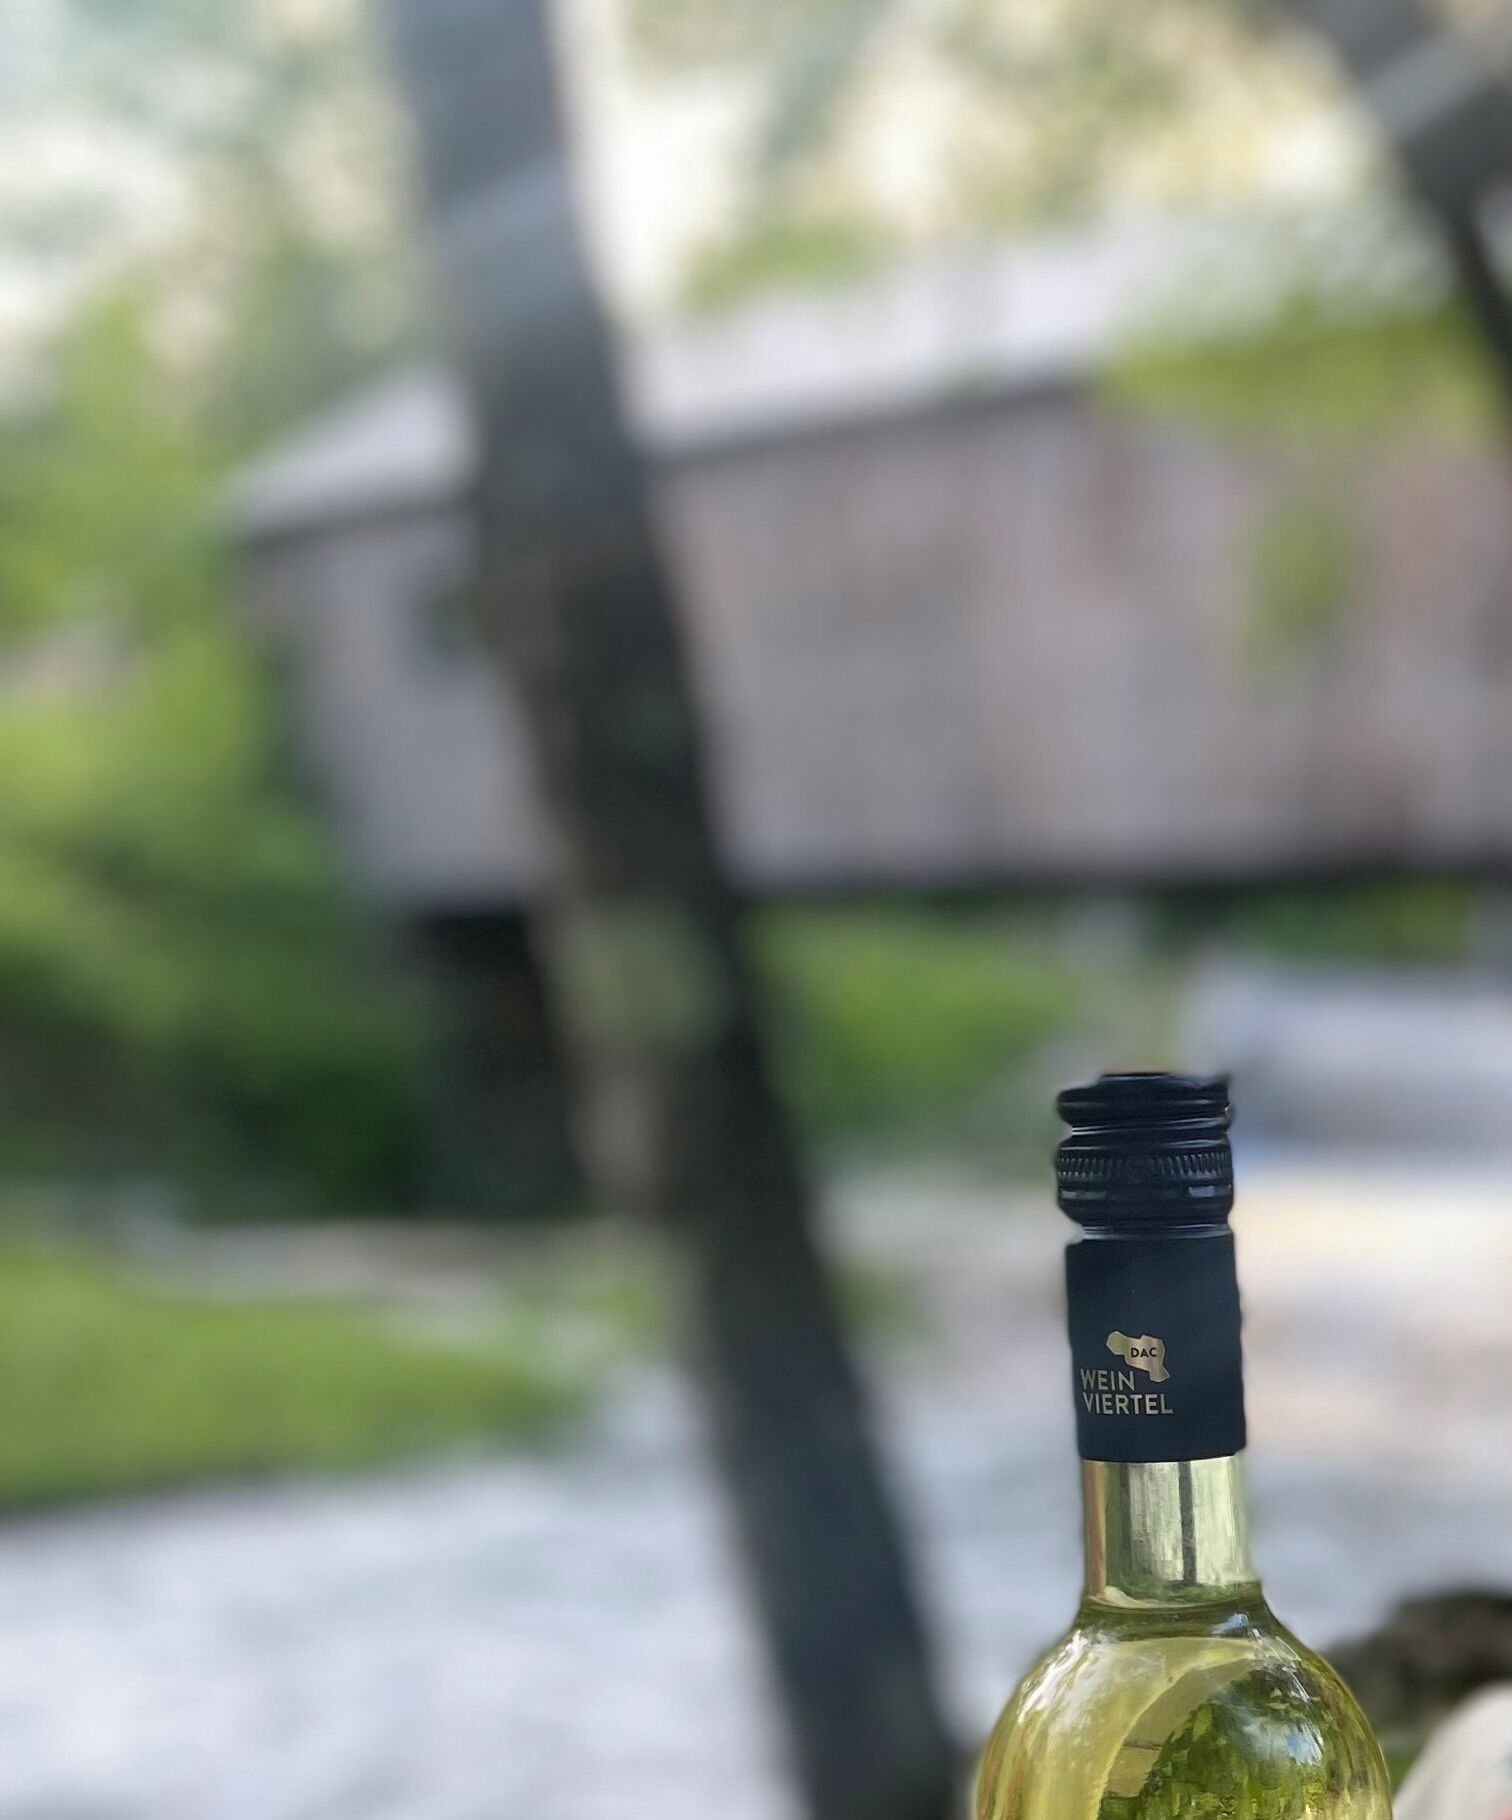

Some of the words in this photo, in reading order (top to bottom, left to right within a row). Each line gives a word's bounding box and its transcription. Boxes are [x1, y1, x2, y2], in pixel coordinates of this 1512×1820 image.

[1130, 1347, 1158, 1358] DAC
[1080, 1367, 1136, 1391] WEIN
[1082, 1392, 1174, 1415] VIERTEL
